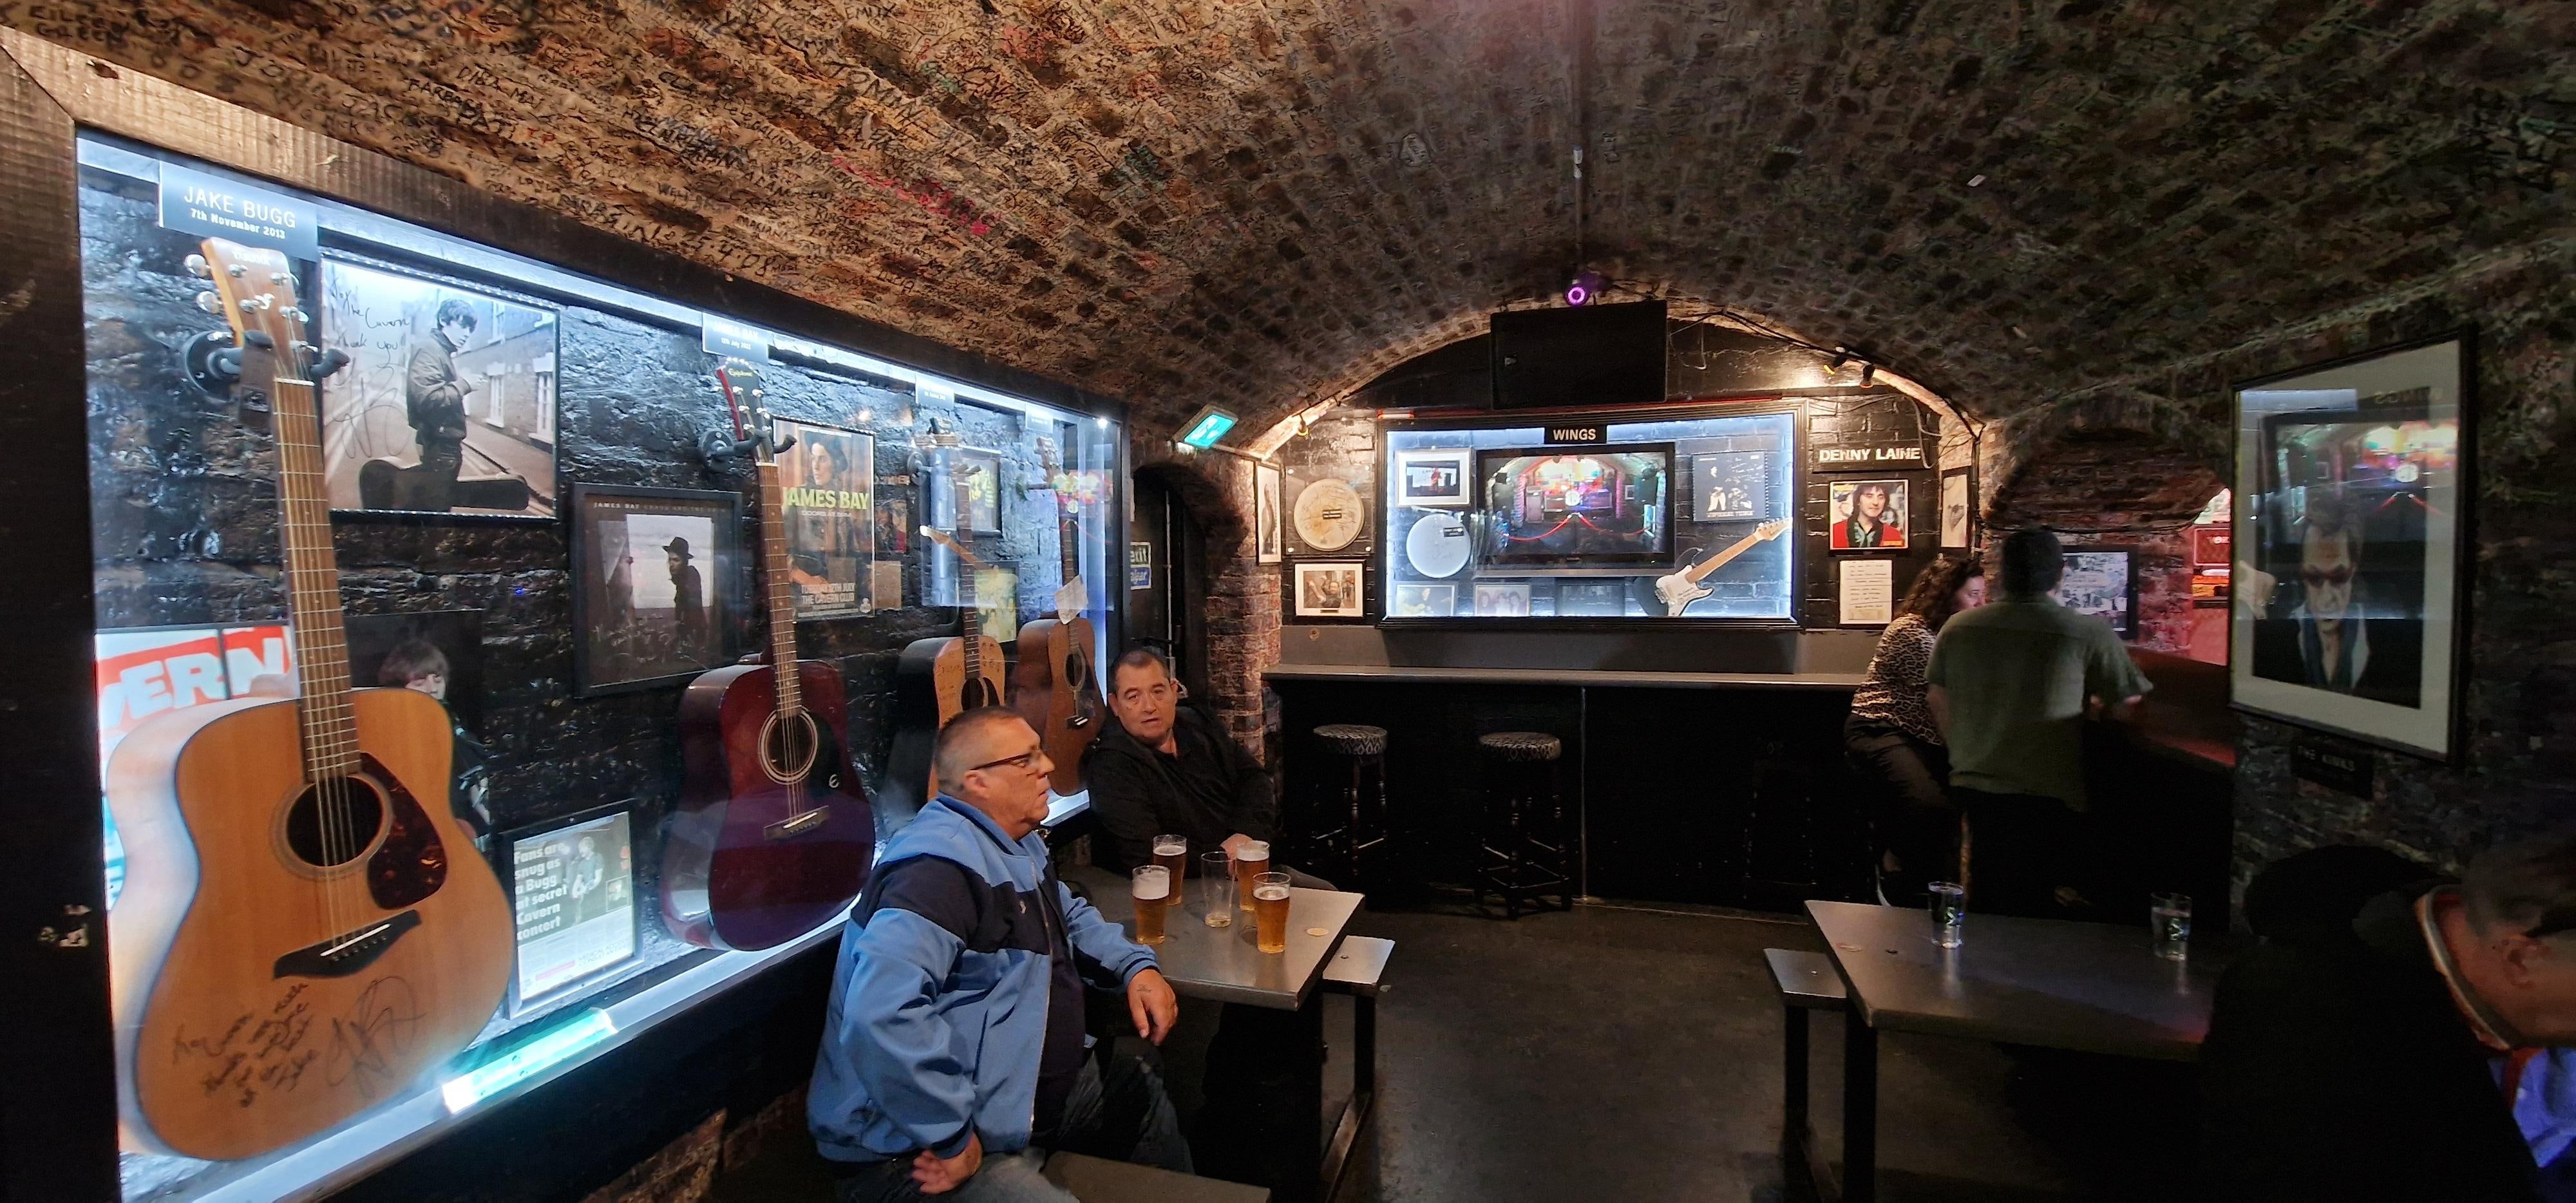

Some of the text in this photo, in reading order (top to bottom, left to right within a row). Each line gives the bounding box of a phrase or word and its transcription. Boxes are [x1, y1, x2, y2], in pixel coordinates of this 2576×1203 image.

[184, 186, 296, 228] JAKE BUGG
[191, 207, 286, 240] 7th November 2013
[1553, 428, 1597, 440] WINGS
[1819, 447, 1922, 462] DENNY LAINE
[782, 488, 871, 510] JAMES BAY
[801, 594, 815, 605] THE
[513, 842, 566, 865] Fans are
[515, 858, 562, 880] snug as
[515, 875, 557, 896] a Bugg
[516, 884, 567, 910] at secret
[517, 902, 560, 925] Cavern
[518, 915, 561, 940] concert
